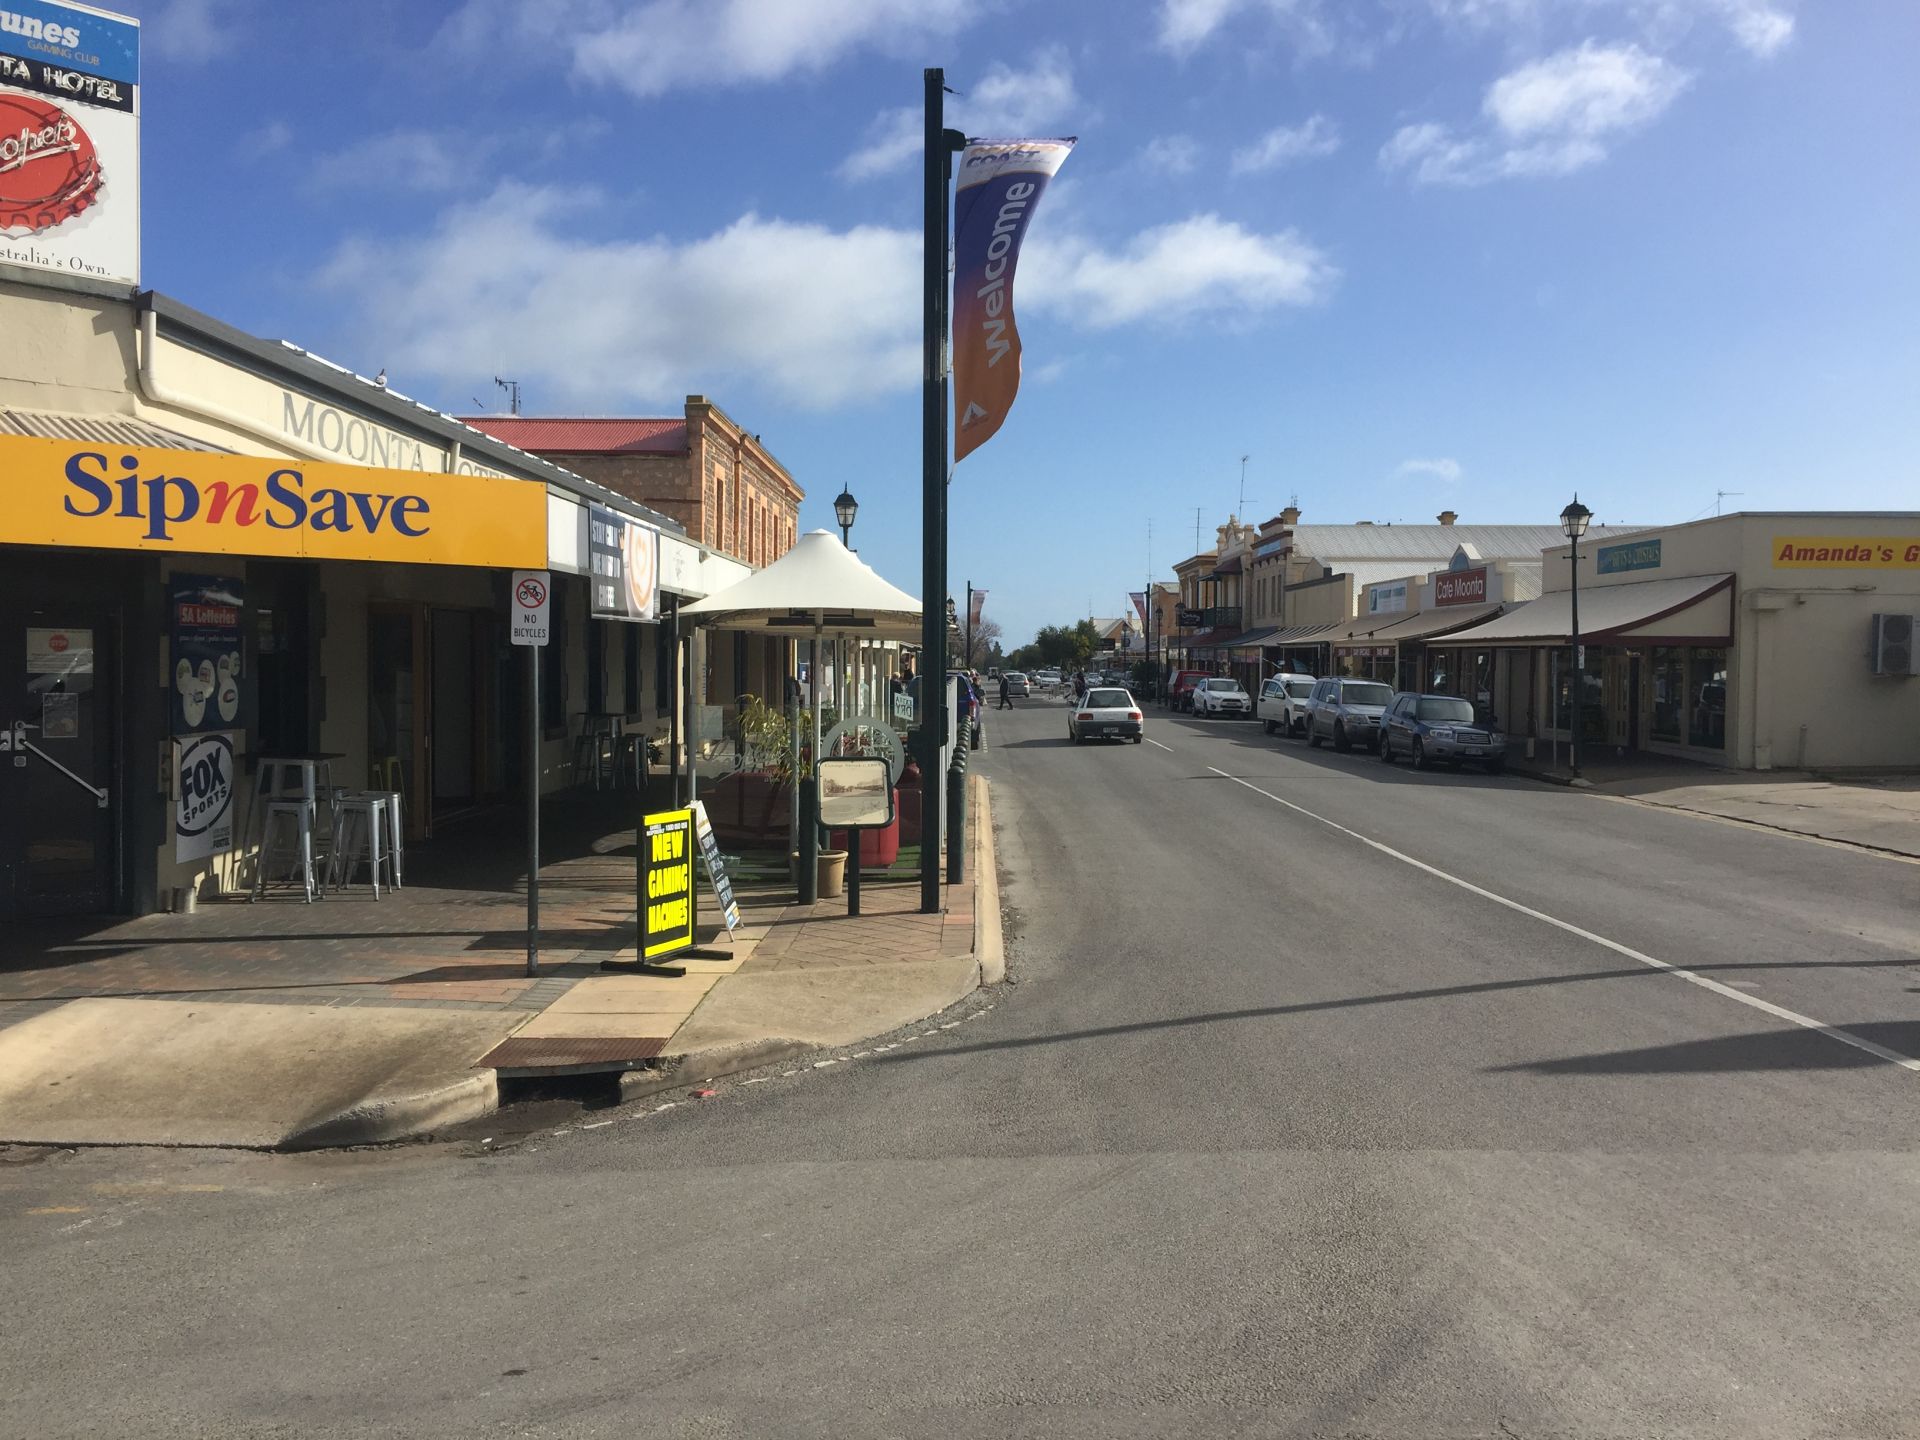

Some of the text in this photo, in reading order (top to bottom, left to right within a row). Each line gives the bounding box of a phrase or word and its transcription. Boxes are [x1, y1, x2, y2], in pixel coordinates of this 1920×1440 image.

[0, 10, 81, 49] unes
[27, 39, 101, 66] GAMING CLUB
[43, 65, 123, 103] HOTEL
[0, 247, 111, 276] stralia's Own.
[283, 392, 424, 472] MOONTA
[1778, 544, 1920, 562] Amanda's G
[1436, 576, 1483, 600] Cafe Moonta
[182, 607, 236, 625] SA Lotteries
[524, 614, 537, 624] NO
[513, 627, 547, 639] BICYCLES
[181, 746, 226, 812] FOX
[184, 785, 228, 825] SPORTS
[652, 830, 684, 863] NEW
[648, 863, 688, 899] GAMING
[648, 897, 688, 935] MACHINES
